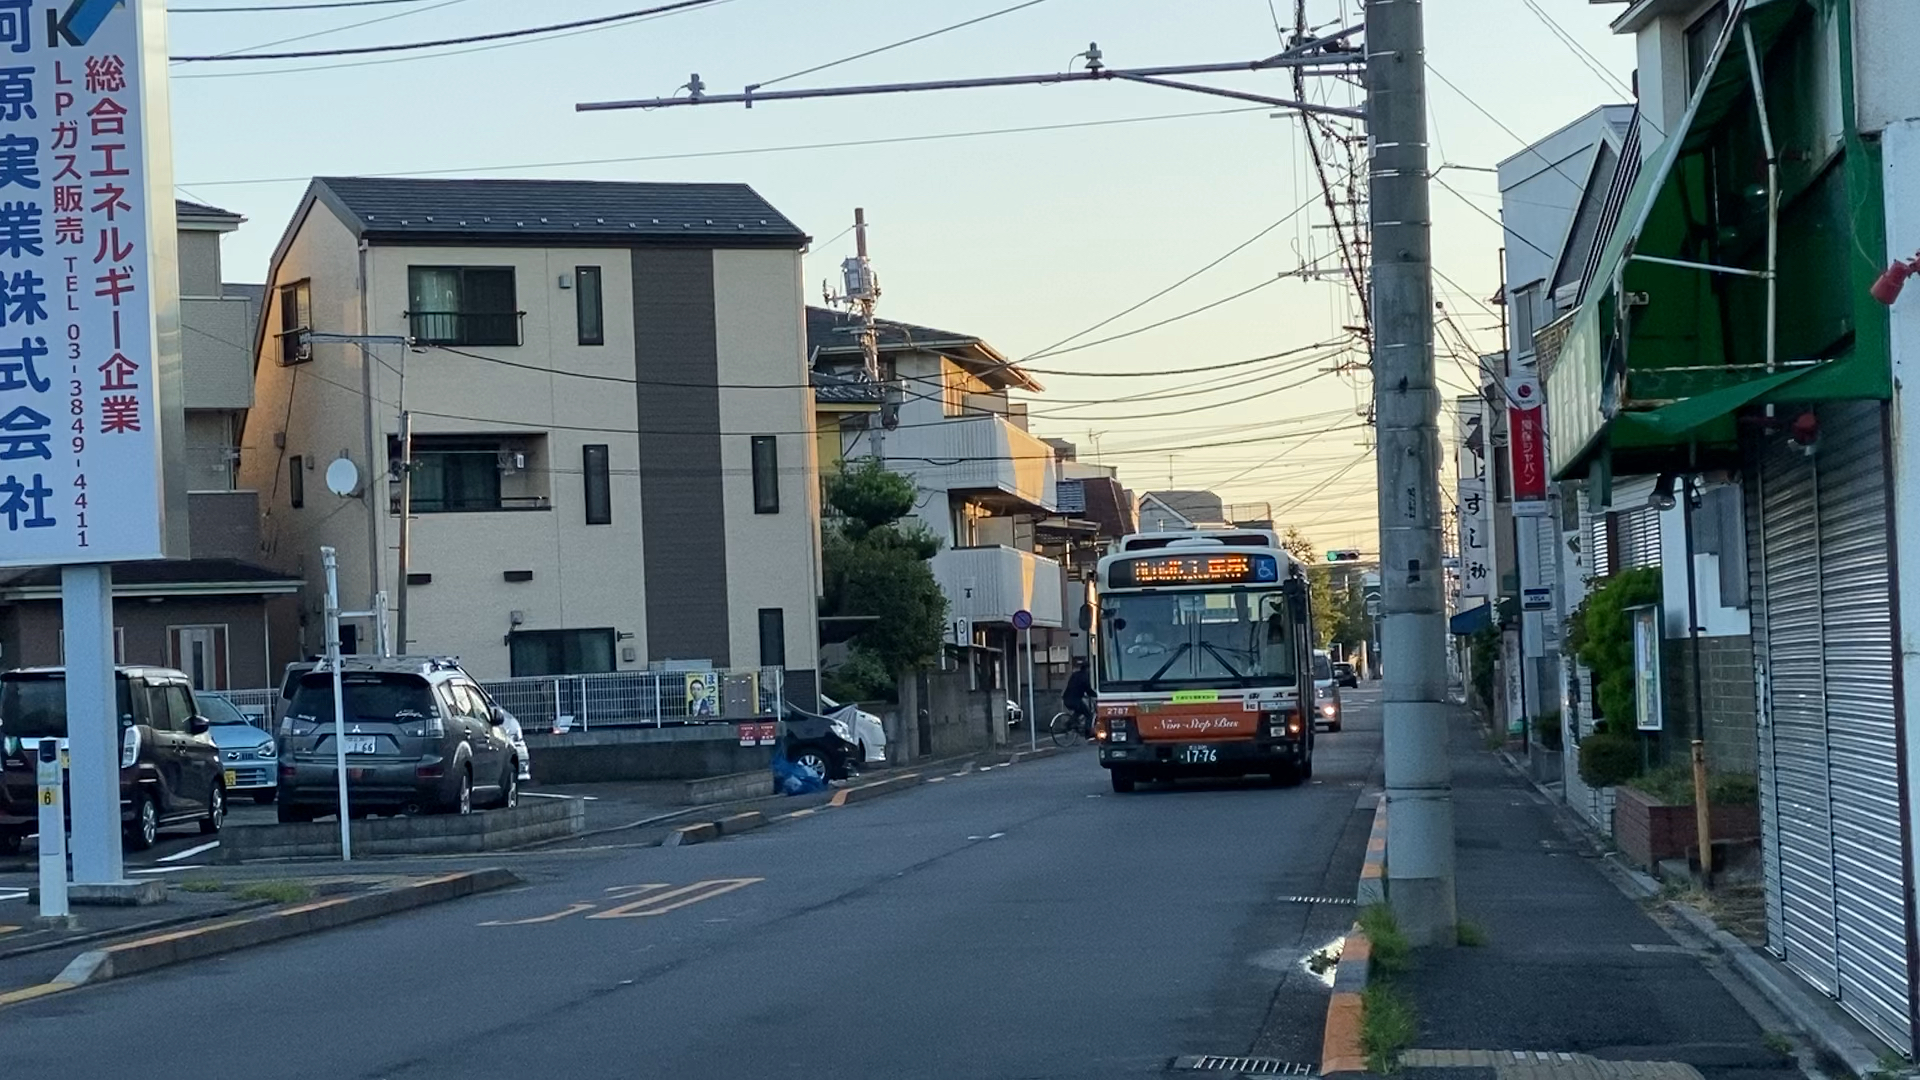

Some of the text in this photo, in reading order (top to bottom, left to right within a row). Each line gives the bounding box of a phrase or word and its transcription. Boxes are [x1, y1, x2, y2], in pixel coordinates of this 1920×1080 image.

[51, 60, 89, 547] LPガス販売 TEL 03-3849-4411
[85, 54, 142, 434] 総合エネルギー企業
[1213, 717, 1239, 728] Bus
